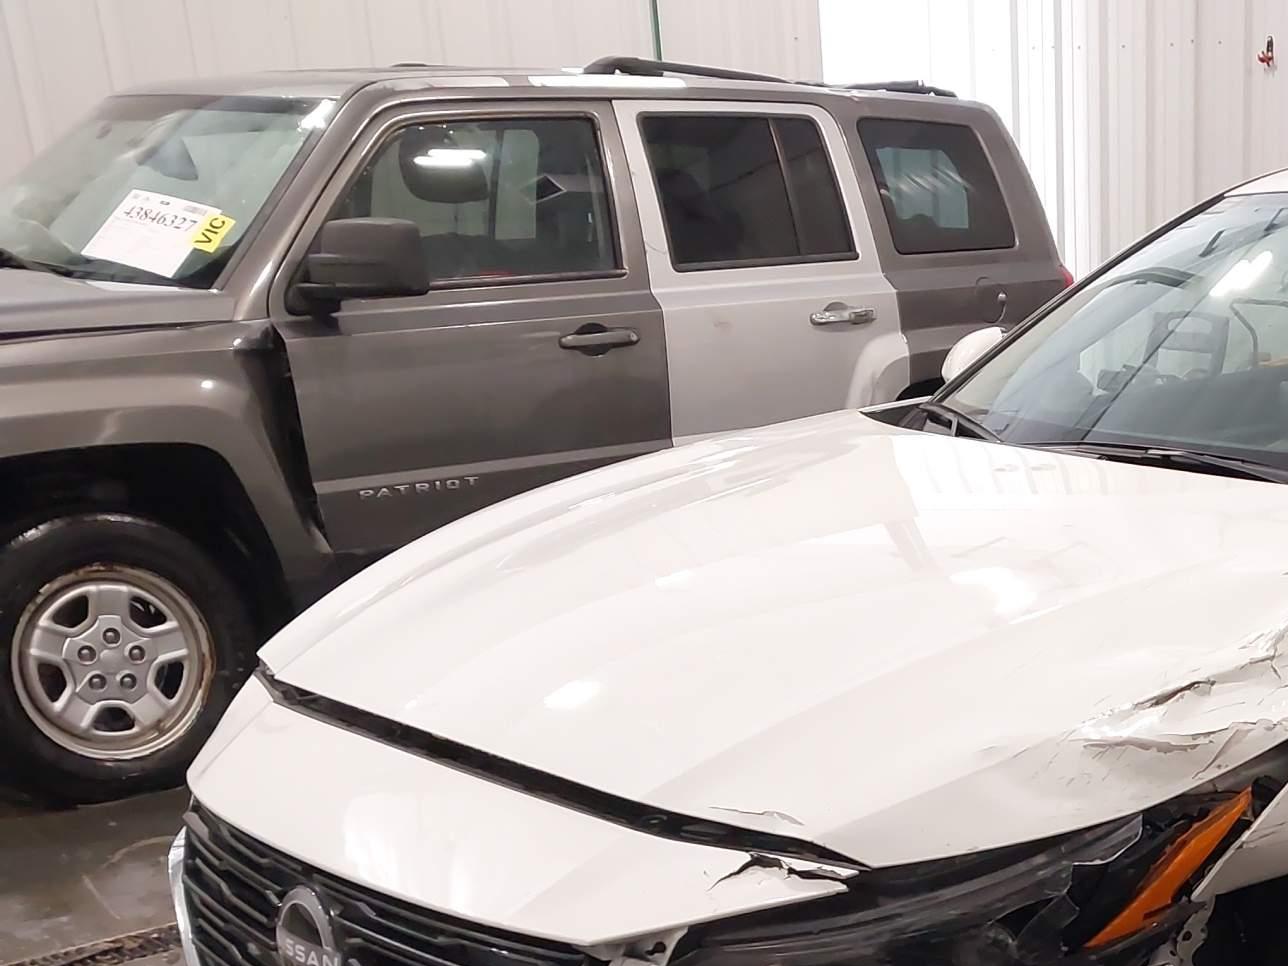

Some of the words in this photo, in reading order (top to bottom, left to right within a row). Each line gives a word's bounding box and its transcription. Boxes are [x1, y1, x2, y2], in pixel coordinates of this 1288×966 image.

[123, 204, 198, 232] 43846327
[194, 217, 226, 246] VIC
[359, 476, 480, 499] PATRIOT
